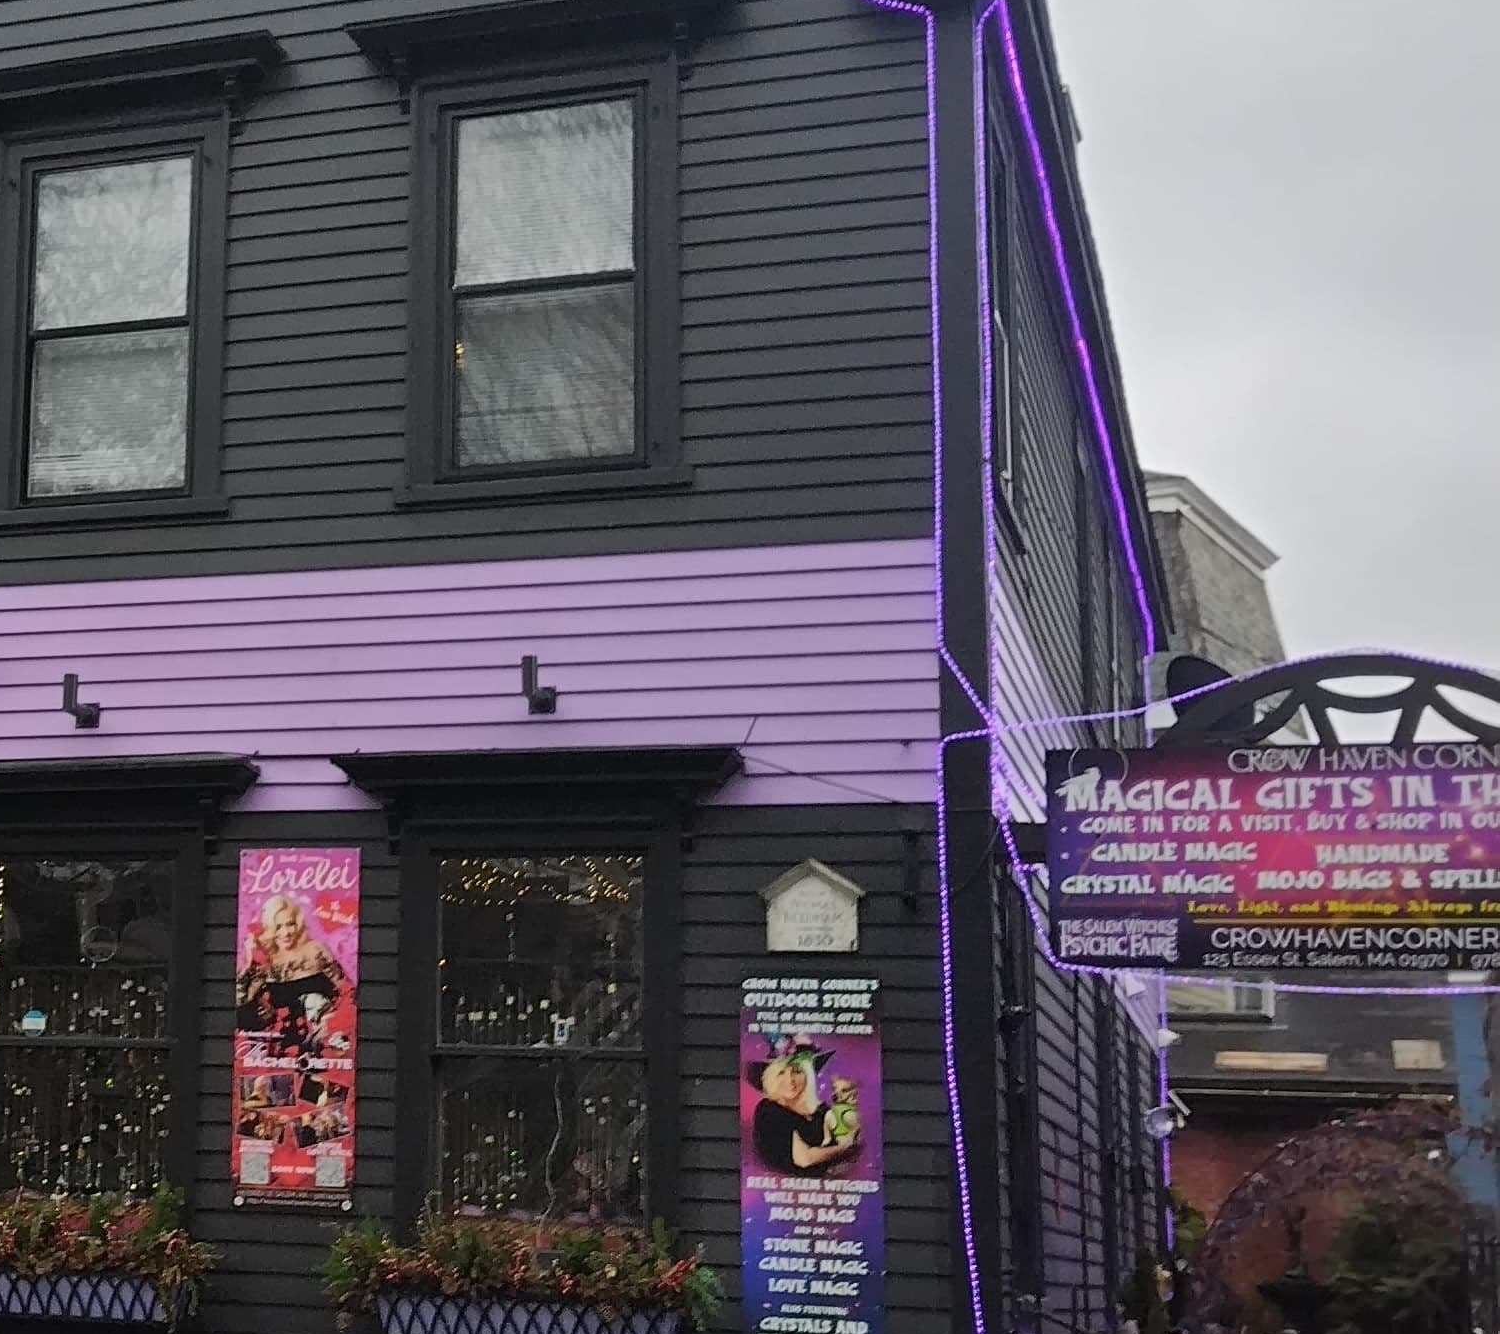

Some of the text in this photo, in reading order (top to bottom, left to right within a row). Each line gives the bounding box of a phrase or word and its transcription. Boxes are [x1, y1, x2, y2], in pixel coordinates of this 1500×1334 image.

[1228, 747, 1312, 773] CROW
[1319, 746, 1406, 771] HAVEN
[1065, 777, 1241, 812] MAGICAL
[1256, 776, 1375, 810] GIFTS
[1389, 774, 1437, 808] IN
[1079, 815, 1137, 834] COME
[1143, 815, 1164, 832] IN
[1172, 815, 1211, 832] FOR
[1217, 816, 1233, 832] A
[1306, 812, 1349, 831] BUY
[1355, 813, 1371, 830] &
[1375, 812, 1435, 831] SHOP
[1440, 811, 1464, 830] IN
[1091, 842, 1450, 864] CANDLE MAGIC HANDMADE
[245, 854, 357, 894] Lorelei
[1060, 868, 1500, 894] CRYSTAL MAGIC MOJO BAGS & SPELL
[1059, 919, 1083, 935] THE
[1211, 927, 1499, 949] CROWHAVENCORNER
[1060, 935, 1179, 962] PSYCHIC FAIRE
[1202, 952, 1230, 967] 125
[1233, 951, 1279, 966] Essex
[1368, 952, 1395, 966] MA
[1399, 952, 1450, 968] 01970
[744, 992, 872, 1008] OUTDOOR STORE
[747, 1176, 880, 1193] REAL SALEM WITCHES
[764, 1191, 794, 1204] WILL
[836, 1194, 861, 1206] YOU
[768, 1207, 856, 1223] MOJO BAGS
[763, 1238, 863, 1255] STONE MAGIC
[758, 1256, 869, 1275] CANDLE MAGIC
[768, 1278, 859, 1296] LOVE MAGIC
[759, 1316, 869, 1334] CRYSTALS AND
